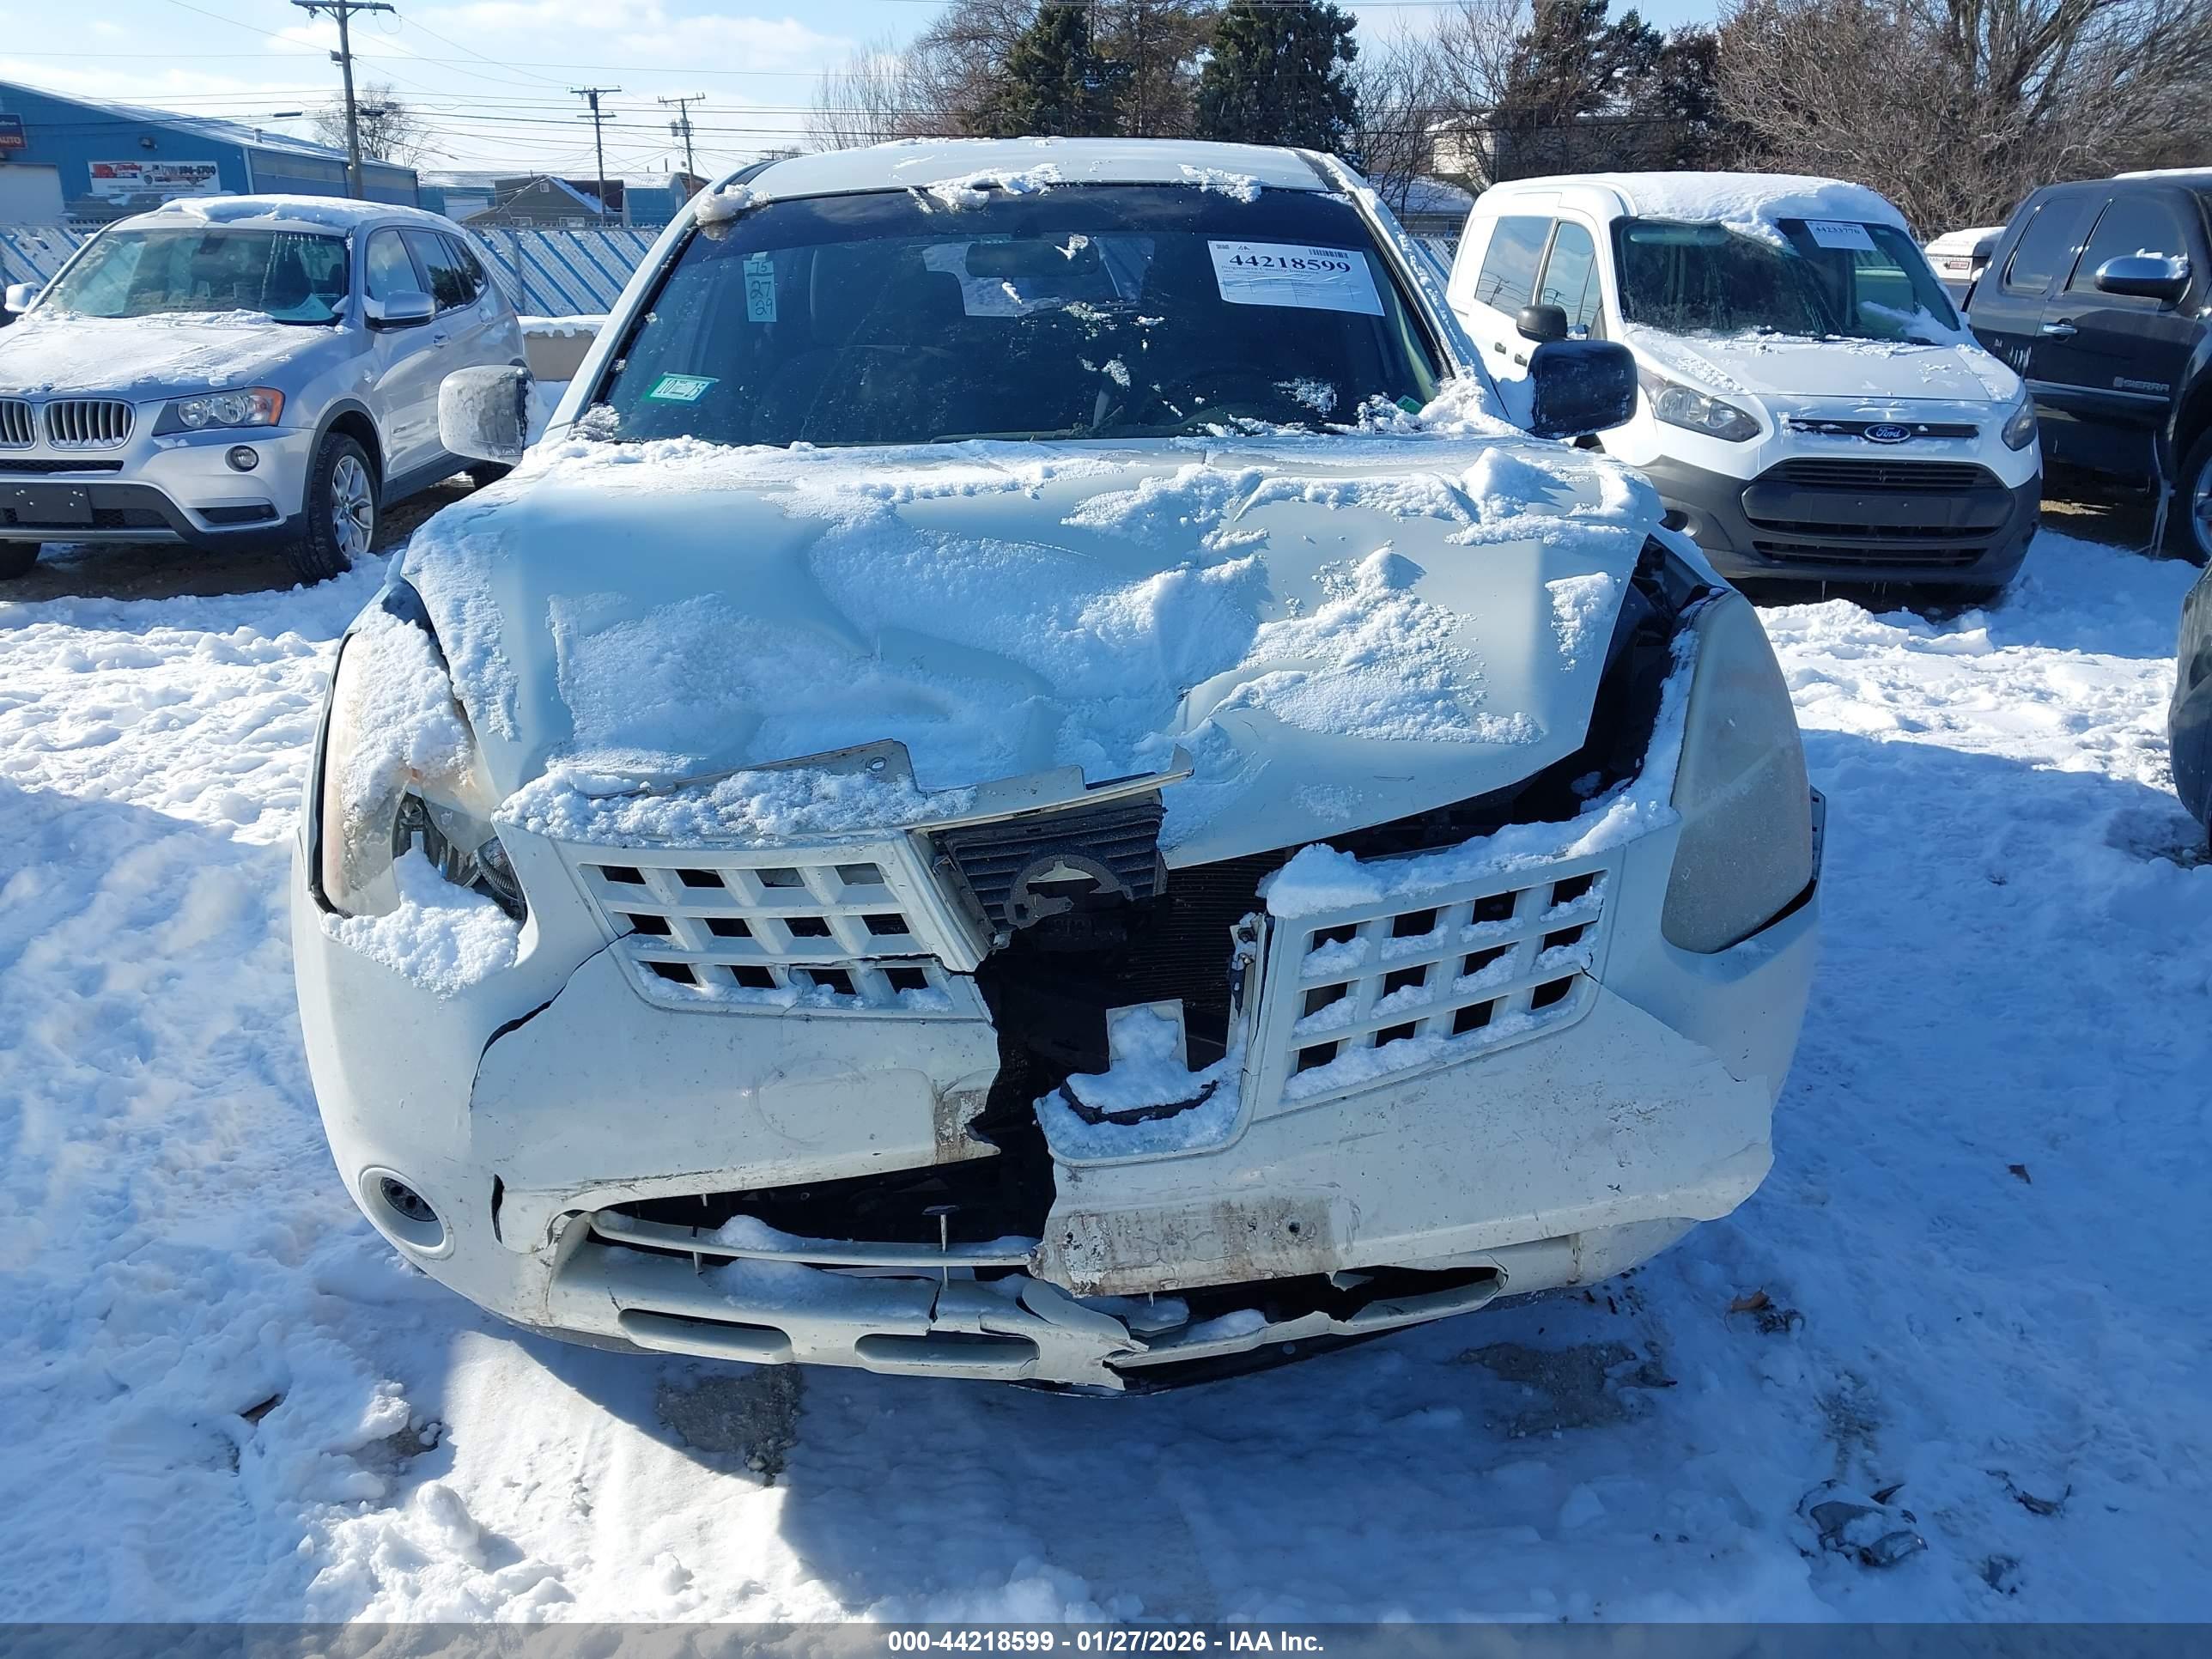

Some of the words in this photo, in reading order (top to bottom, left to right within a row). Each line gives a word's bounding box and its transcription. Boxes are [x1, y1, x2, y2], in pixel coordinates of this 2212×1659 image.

[750, 260, 769, 274] 75
[1229, 253, 1351, 273] 44218599
[750, 280, 771, 299] 27
[755, 297, 773, 316] 29
[2123, 379, 2170, 392] SIERRA
[1875, 427, 1901, 438] Ford
